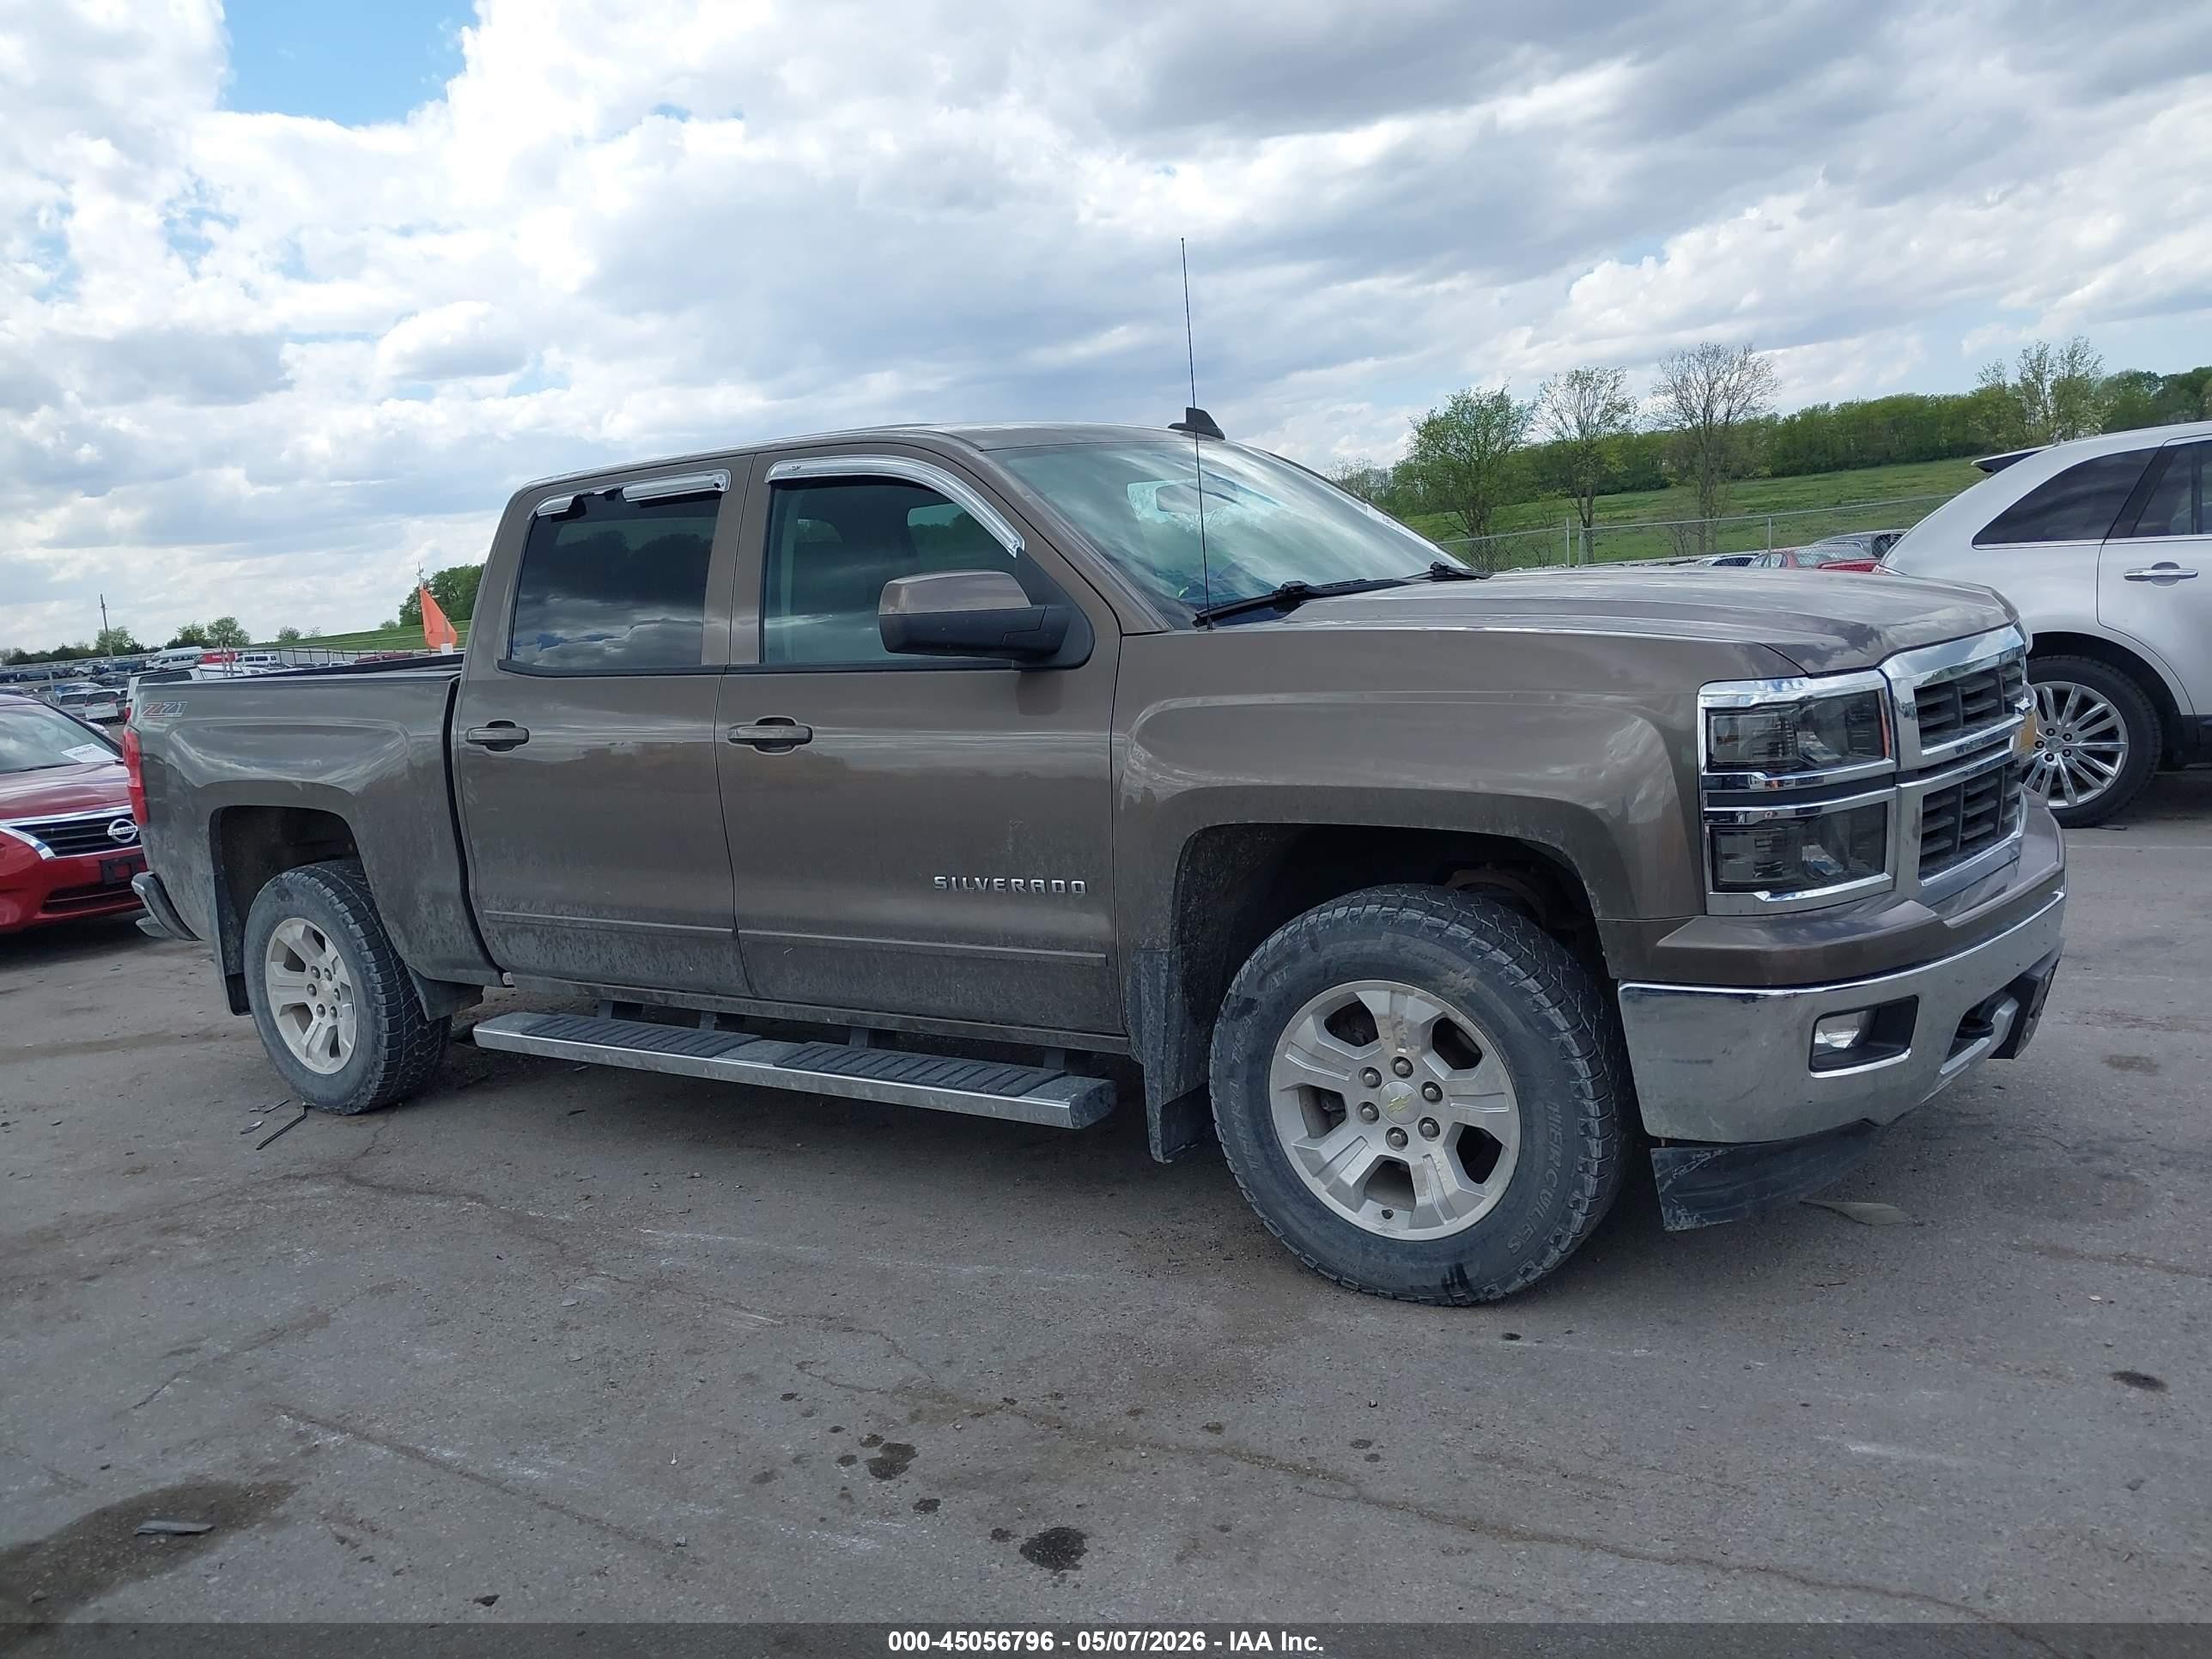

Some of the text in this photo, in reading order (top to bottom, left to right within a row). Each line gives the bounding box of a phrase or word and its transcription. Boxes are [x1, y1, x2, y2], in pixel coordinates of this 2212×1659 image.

[142, 701, 188, 718] Z71
[110, 825, 137, 835] NISSAN
[933, 876, 1087, 894] SILVERADO
[1507, 1100, 1564, 1255] HERCULES
